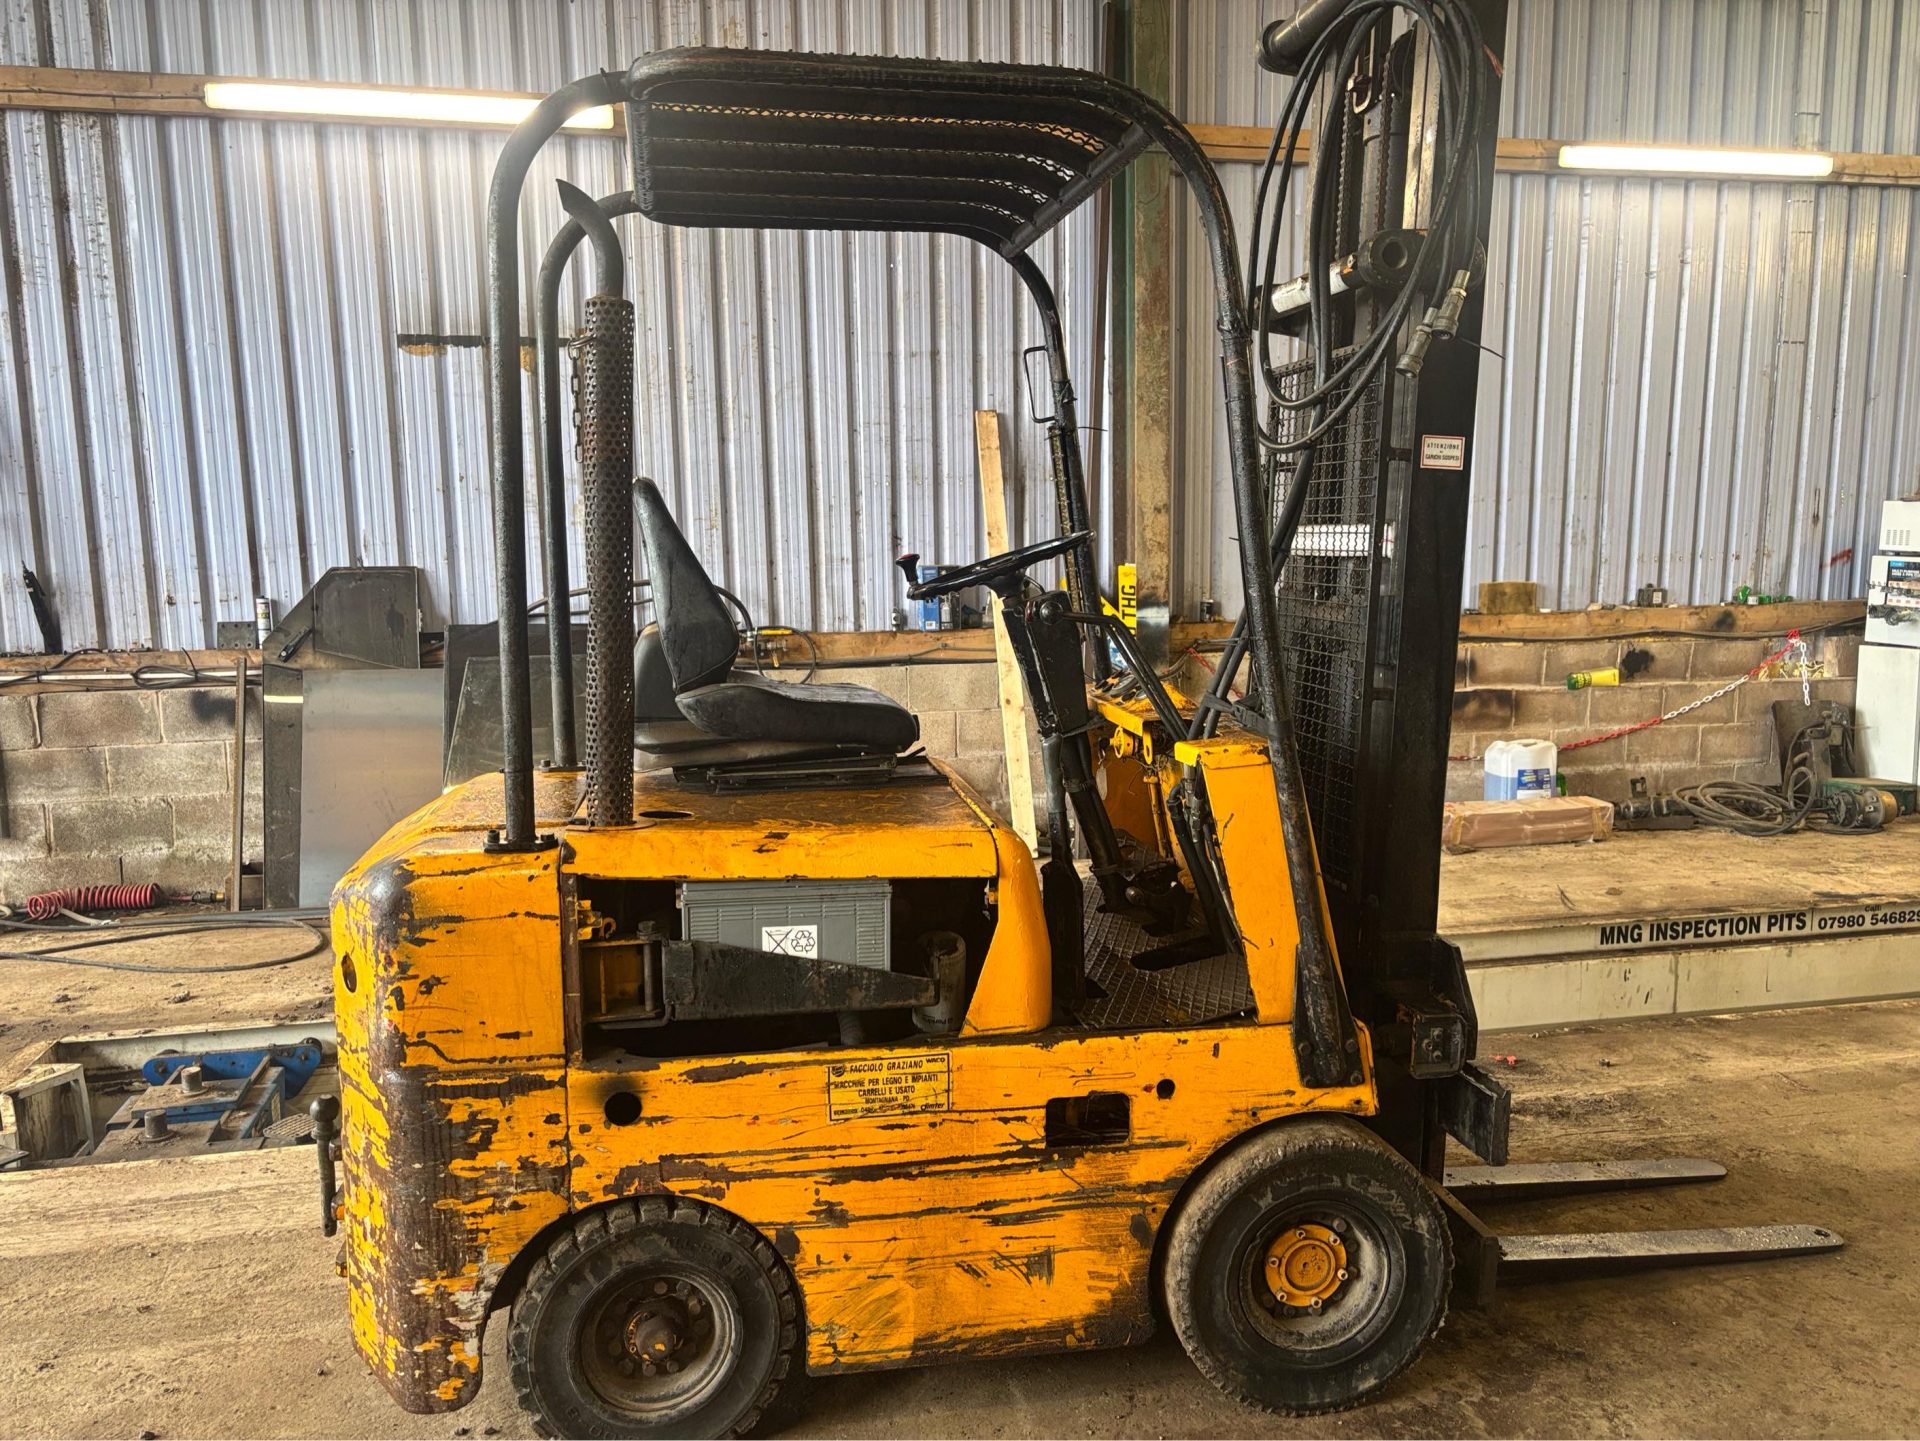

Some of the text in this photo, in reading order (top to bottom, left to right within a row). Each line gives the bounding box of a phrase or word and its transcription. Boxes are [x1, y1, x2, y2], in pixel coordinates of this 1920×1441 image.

[1600, 912, 1807, 945] MNG INSPECTION PITS
[1818, 914, 1865, 930] 07980
[850, 1060, 923, 1074] FACCIOLO GRAZIANO
[868, 1078, 880, 1086] PER
[882, 1076, 903, 1086] LEGNO
[911, 1074, 938, 1083] IMPIANTI
[858, 1085, 915, 1097] CARRELLI E USATO
